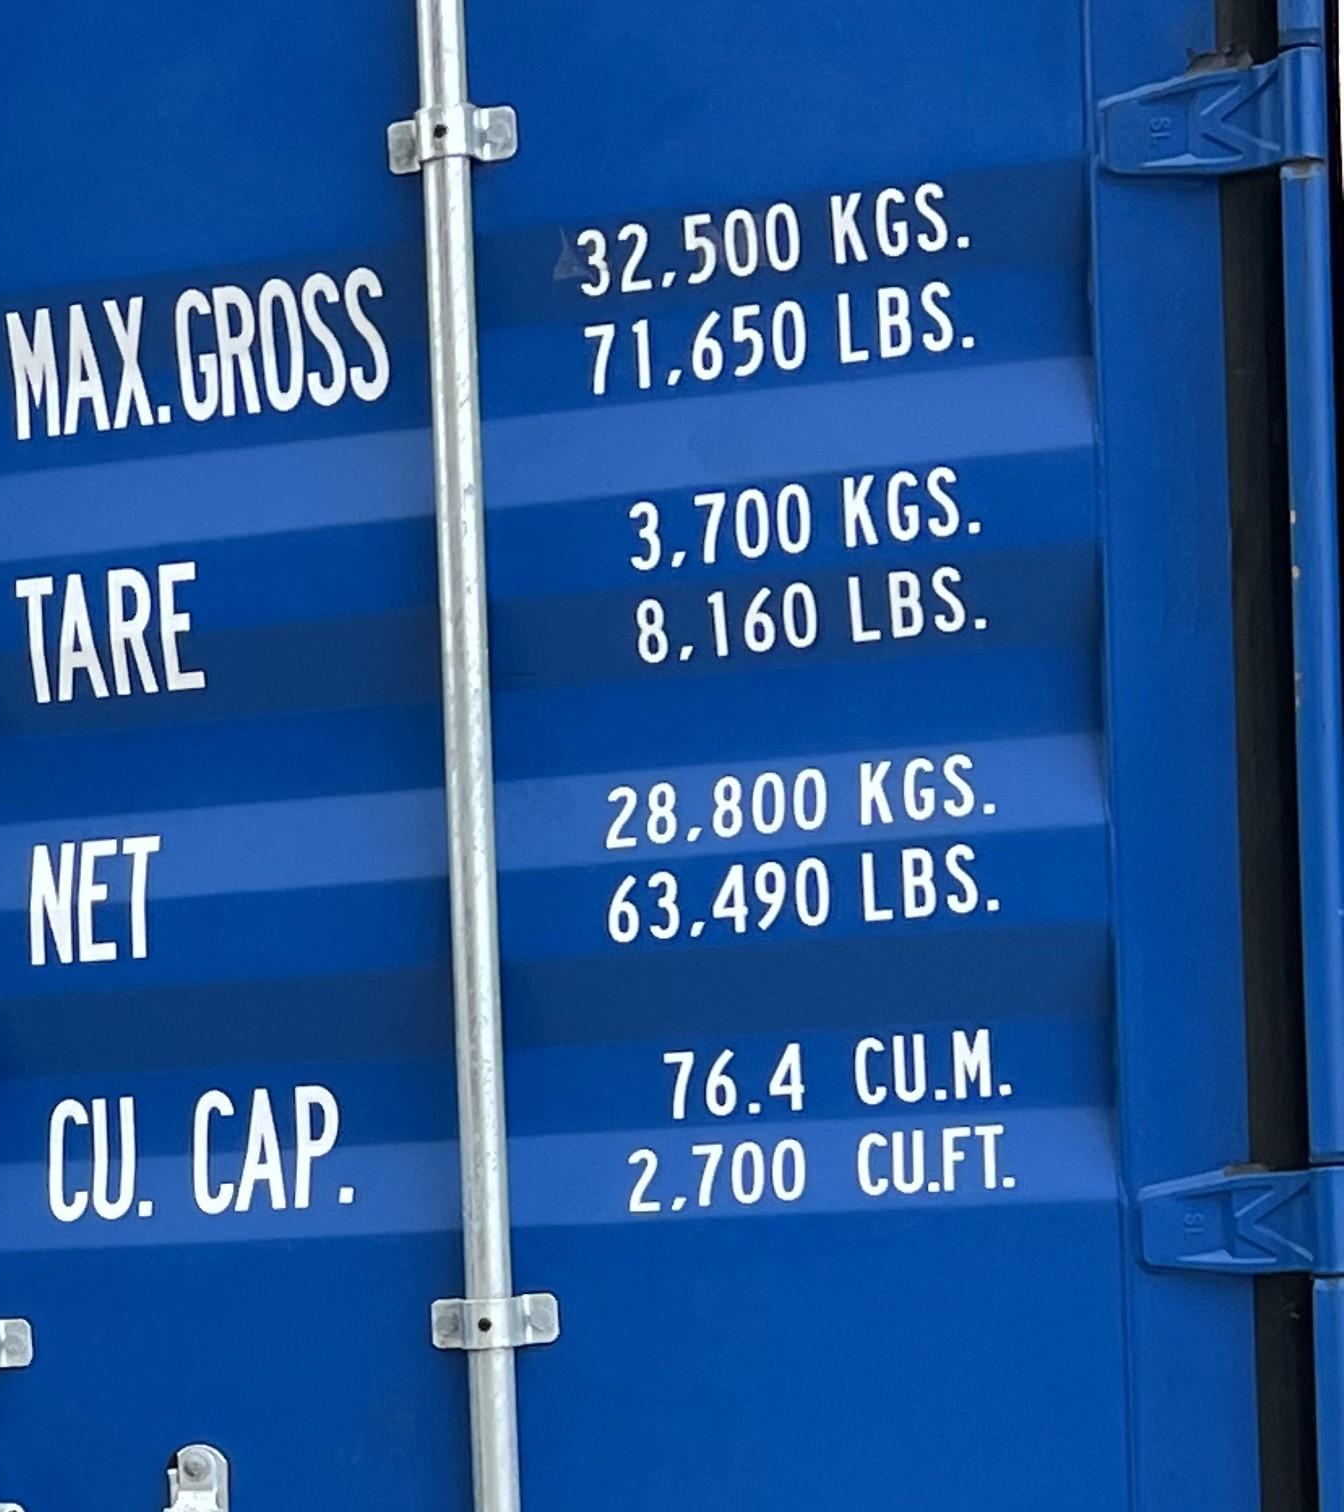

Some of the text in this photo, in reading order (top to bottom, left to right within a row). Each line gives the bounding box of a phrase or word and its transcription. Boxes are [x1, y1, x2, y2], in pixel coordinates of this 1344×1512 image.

[577, 183, 969, 296] 32,500 KGS.
[584, 281, 974, 395] 71,650 LBS.
[629, 467, 980, 571] 3,700 KGS.
[15, 561, 205, 704] TARE
[636, 566, 987, 663] 8,160 LBS.
[606, 754, 996, 849] 28,800 KGS.
[30, 835, 161, 965] NET
[608, 844, 999, 943] 63,490 LBS.
[663, 1029, 1012, 1120] 76.4 CU.M.
[49, 1085, 354, 1222] CU. CAP.
[628, 1124, 1015, 1212] 2,700 CU.FT.
